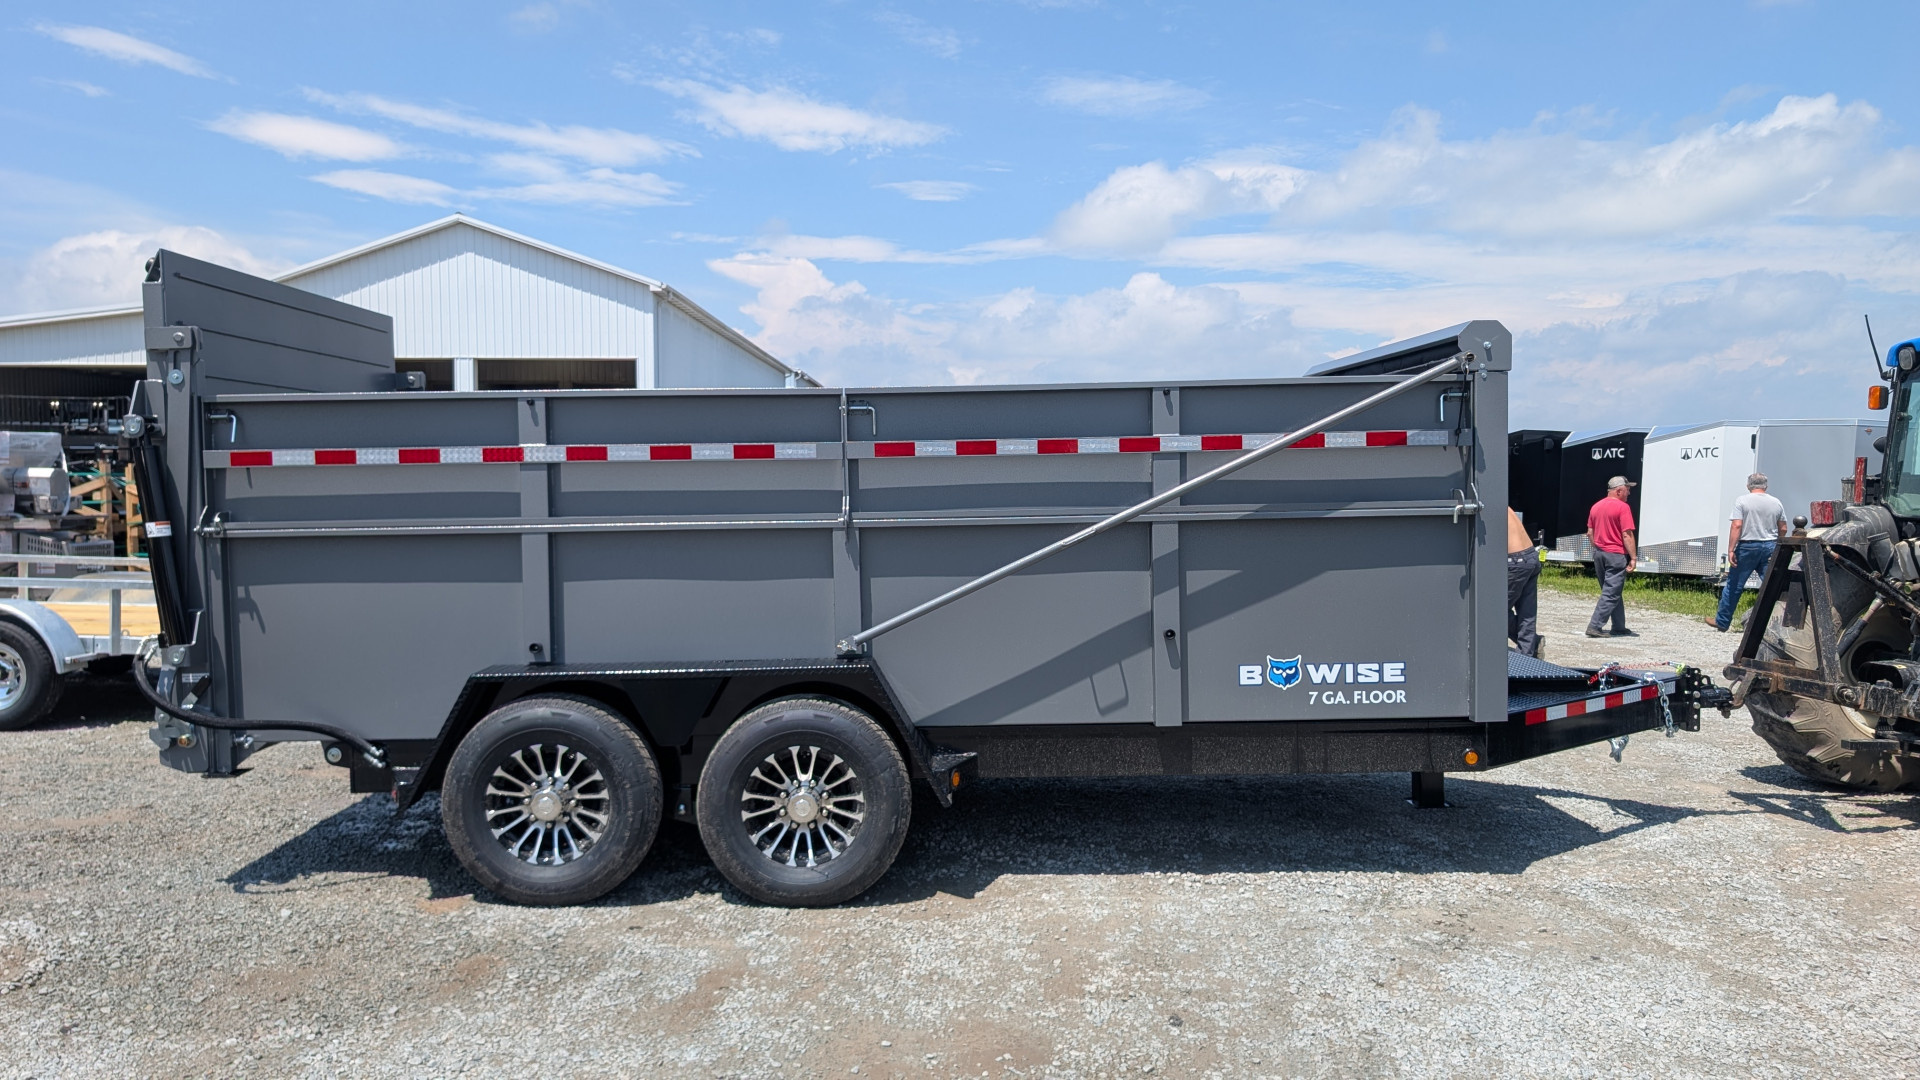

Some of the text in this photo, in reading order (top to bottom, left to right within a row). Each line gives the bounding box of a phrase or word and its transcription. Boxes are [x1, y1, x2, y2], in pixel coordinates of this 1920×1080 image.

[1603, 447, 1625, 459] ATC
[1694, 446, 1719, 459] ATC
[1308, 690, 1407, 705] 7 GA. FLOOR
